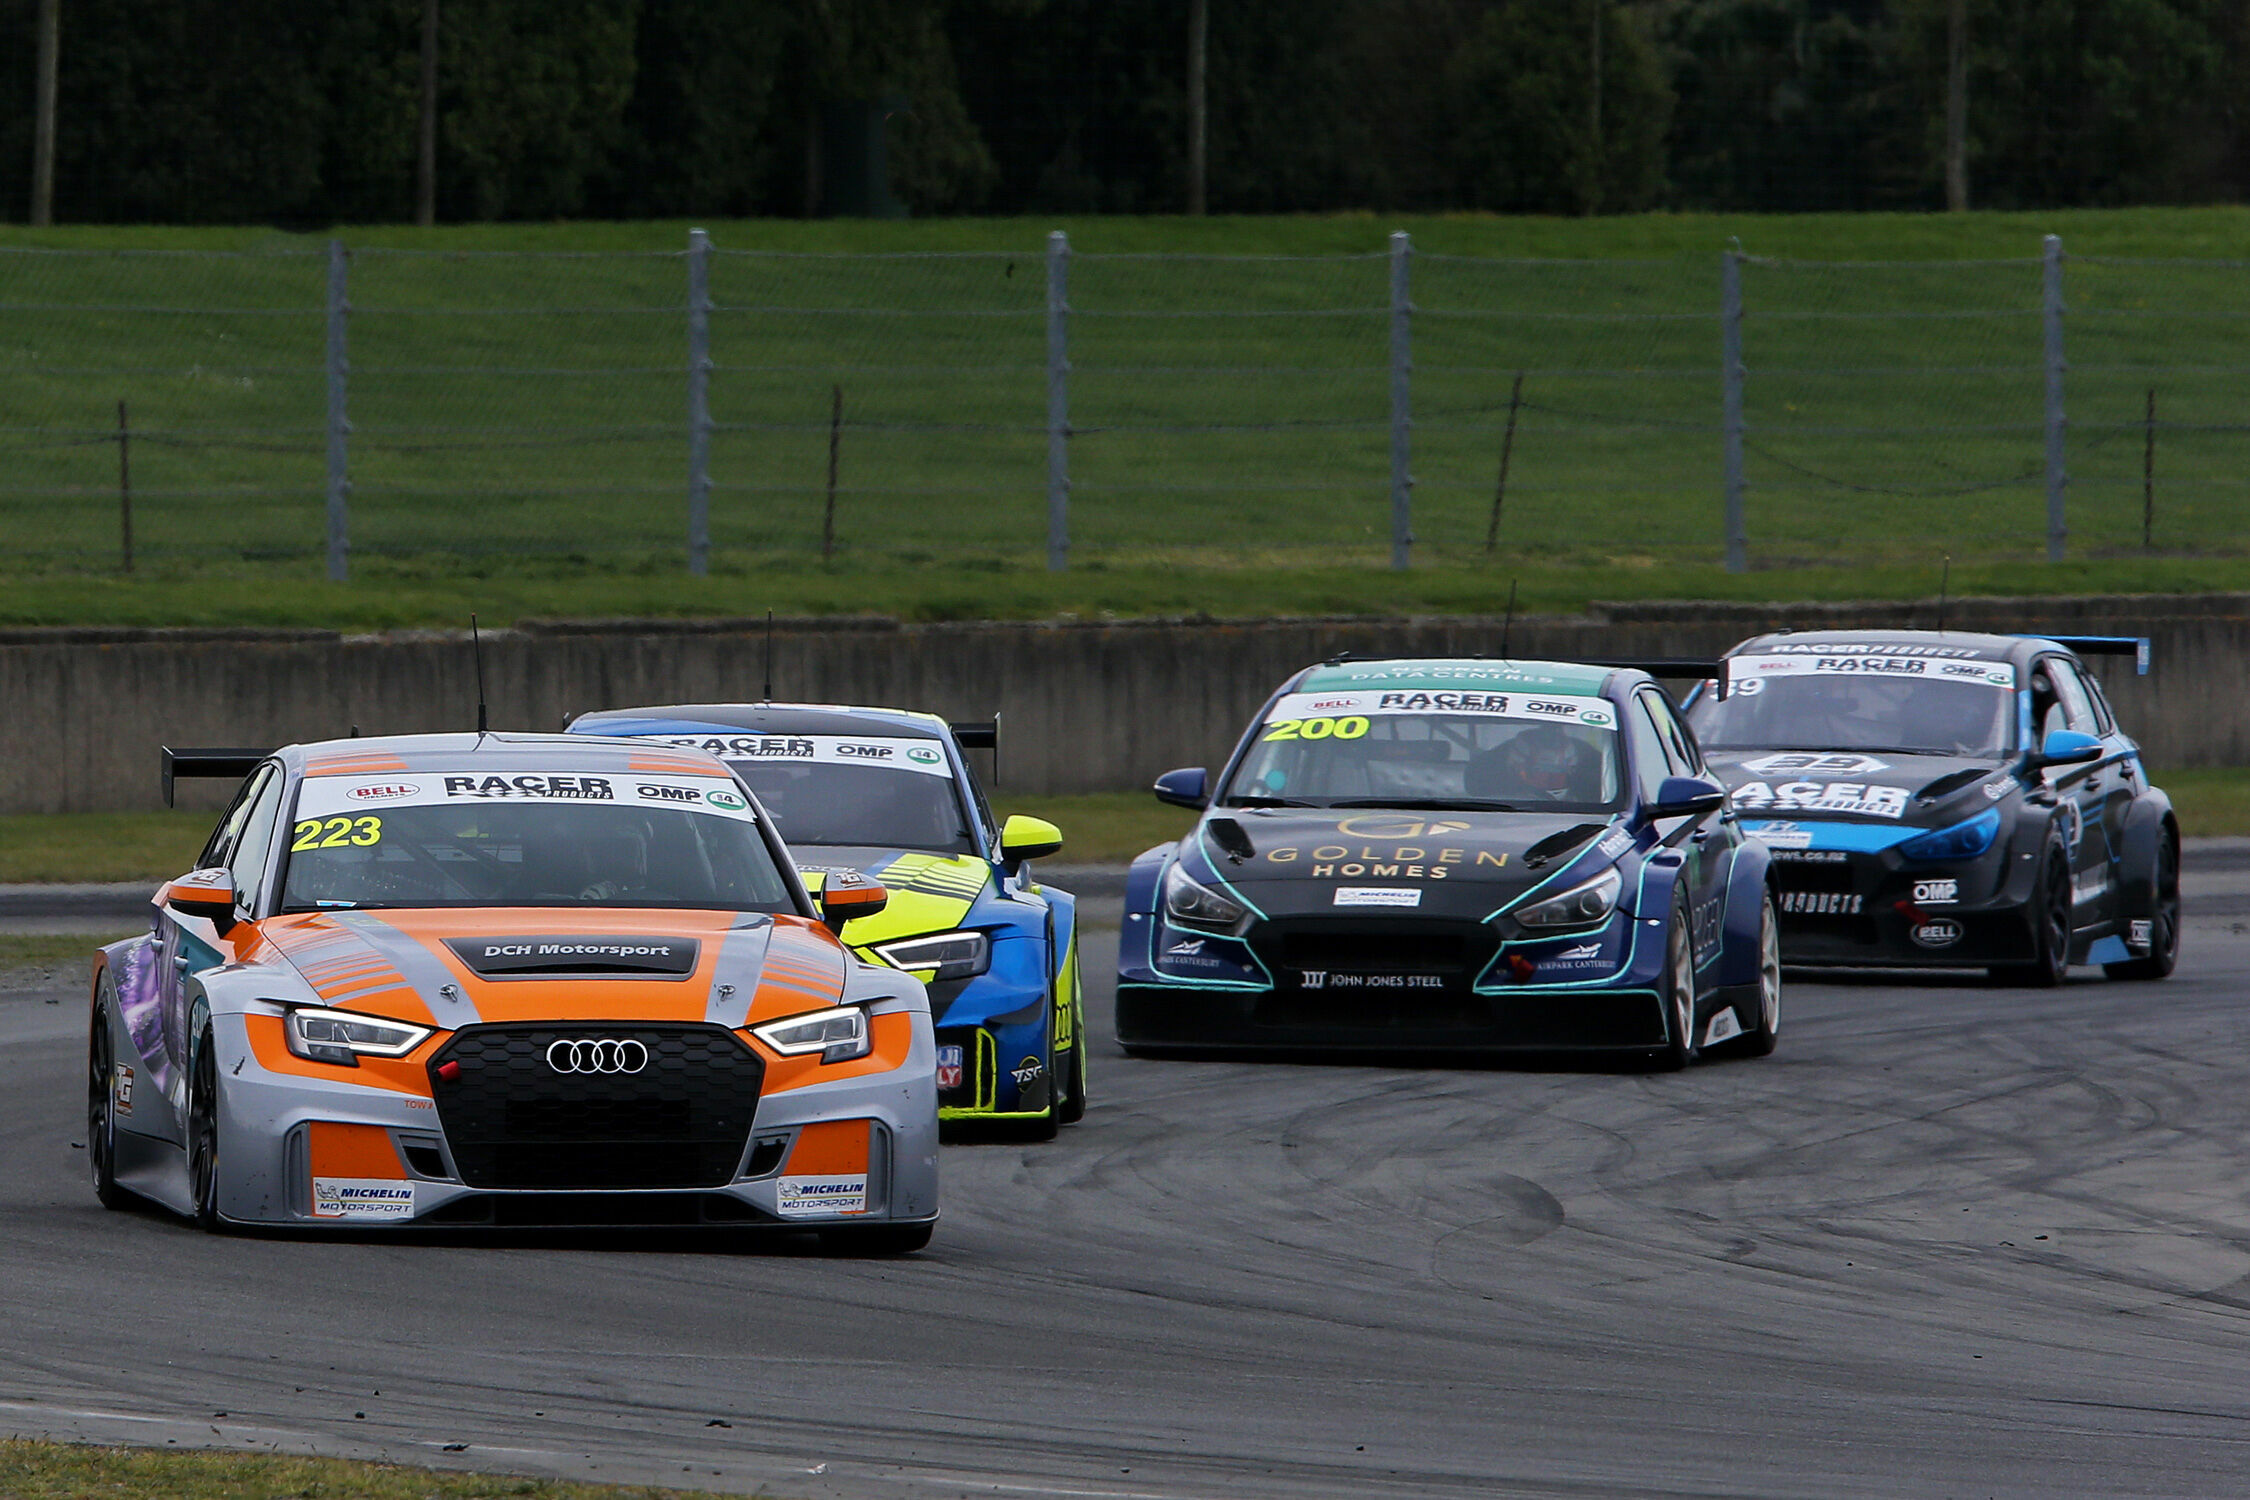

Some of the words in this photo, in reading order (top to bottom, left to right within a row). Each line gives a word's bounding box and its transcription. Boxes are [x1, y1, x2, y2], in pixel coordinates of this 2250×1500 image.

[1771, 645, 1868, 653] RACER
[1817, 658, 1926, 672] RACER
[1351, 672, 1425, 680] DATA
[1432, 671, 1553, 683] CENTRES
[1314, 700, 1354, 708] BELL
[1380, 693, 1510, 712] RACER
[1527, 702, 1577, 713] OMP
[1263, 716, 1370, 742] 200
[836, 746, 893, 756] OMP
[356, 786, 412, 796] BELL
[444, 776, 615, 798] RACER
[544, 790, 612, 799] PRODUCTS
[637, 786, 701, 801] OMP
[1731, 782, 1911, 818] ACER
[1809, 800, 1900, 814] PRODUCTS
[291, 816, 382, 852] 223
[1267, 845, 1509, 867] GOLDEN
[1773, 850, 1847, 861] ews.co.nz
[1312, 864, 1448, 879] HOMES
[1913, 883, 1958, 900] OMP
[1919, 925, 1956, 937] BELL
[484, 945, 532, 957] DCH
[538, 944, 670, 957] Motorsport
[1330, 974, 1363, 987] JOHN
[1365, 976, 1404, 987] JONES
[1407, 976, 1444, 987] STEEL
[404, 1100, 426, 1109] TOW
[340, 1188, 412, 1199] MICHELIN
[800, 1183, 864, 1195] MICHELIN
[319, 1202, 412, 1213] MOTORSPORT
[781, 1199, 863, 1209] MOTORSPORT
